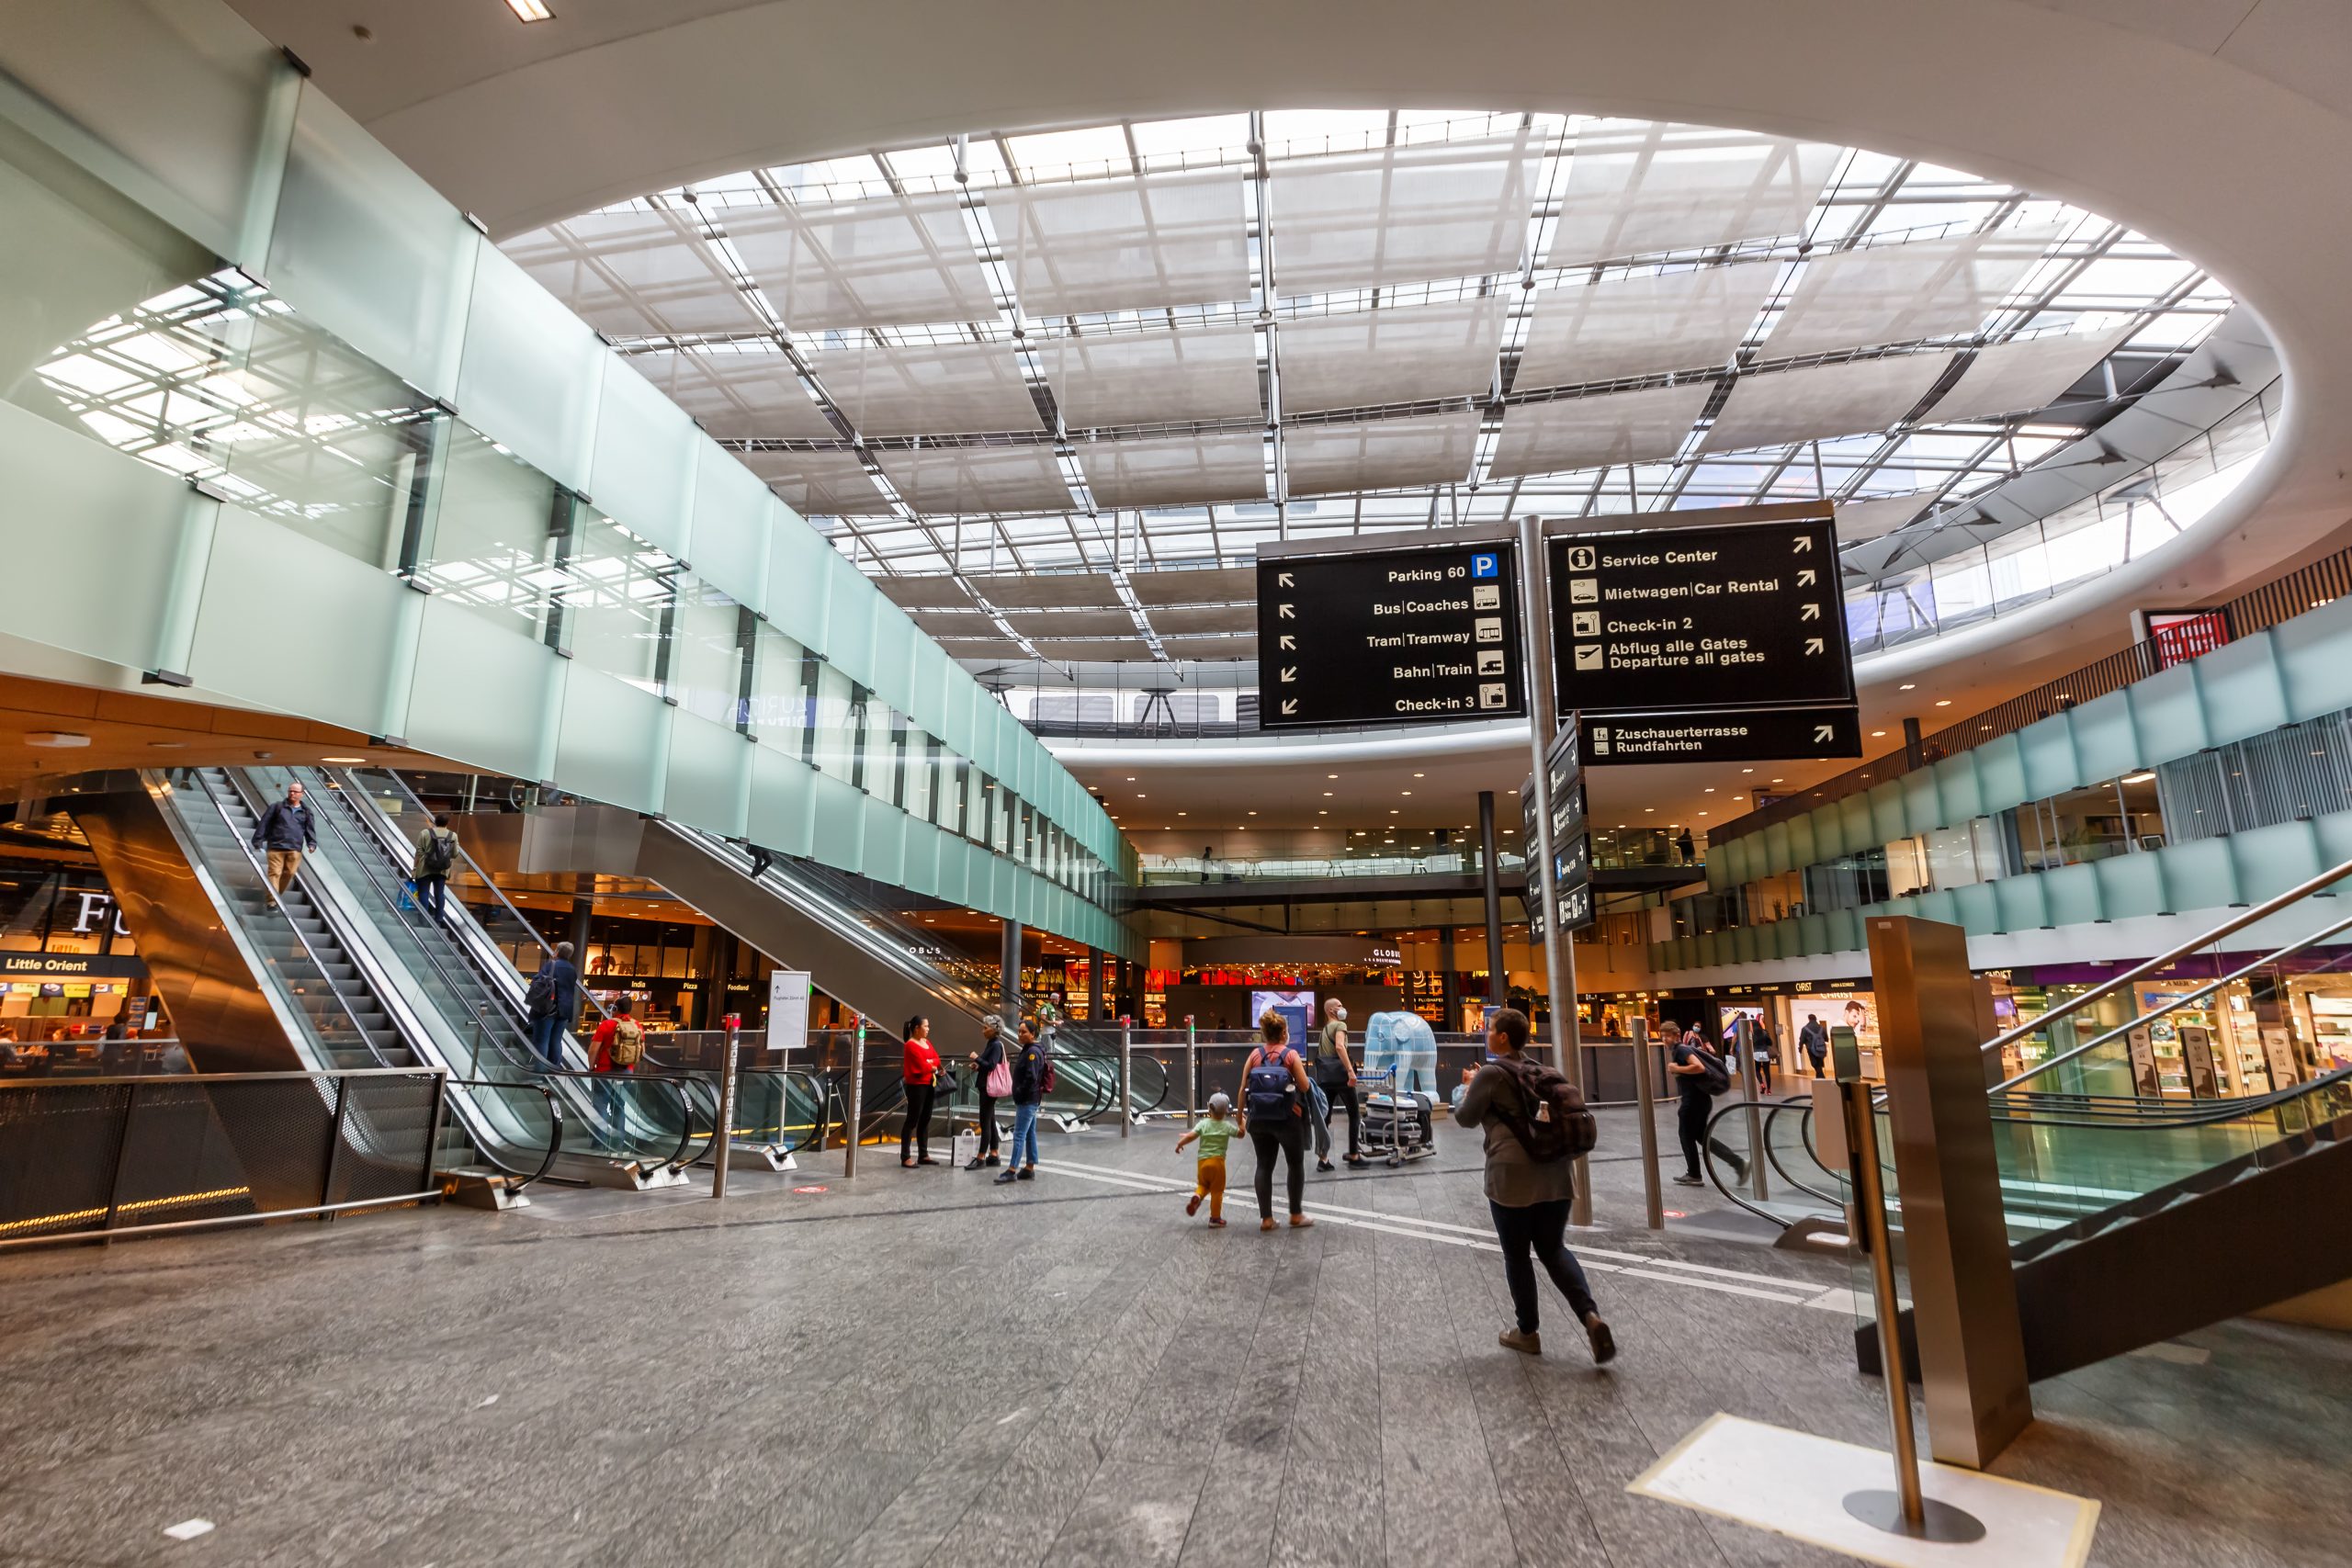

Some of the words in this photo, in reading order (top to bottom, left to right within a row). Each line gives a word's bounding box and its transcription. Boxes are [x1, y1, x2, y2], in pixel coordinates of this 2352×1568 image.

[1602, 554, 1659, 568] Service
[1665, 550, 1717, 563] Center
[1388, 570, 1442, 583] Parking
[1447, 567, 1465, 578] 60
[1728, 579, 1779, 593] Rental
[1607, 619, 1677, 633] Check-in
[1683, 617, 1692, 629] 2
[1609, 642, 1660, 655] Abflug
[1666, 640, 1694, 652] alle
[1701, 638, 1747, 650] Gates
[1611, 655, 1689, 670] Departure
[1695, 652, 1713, 664] all
[1720, 651, 1765, 666] gates
[1395, 698, 1460, 711] Check-in
[1465, 696, 1475, 707] 3
[1615, 727, 1748, 740] Zuschauerterrasse
[1617, 740, 1702, 752] Rundfahrten
[6, 958, 42, 970] Little
[45, 960, 87, 972] Orient
[1796, 982, 1813, 992] CHRIST
